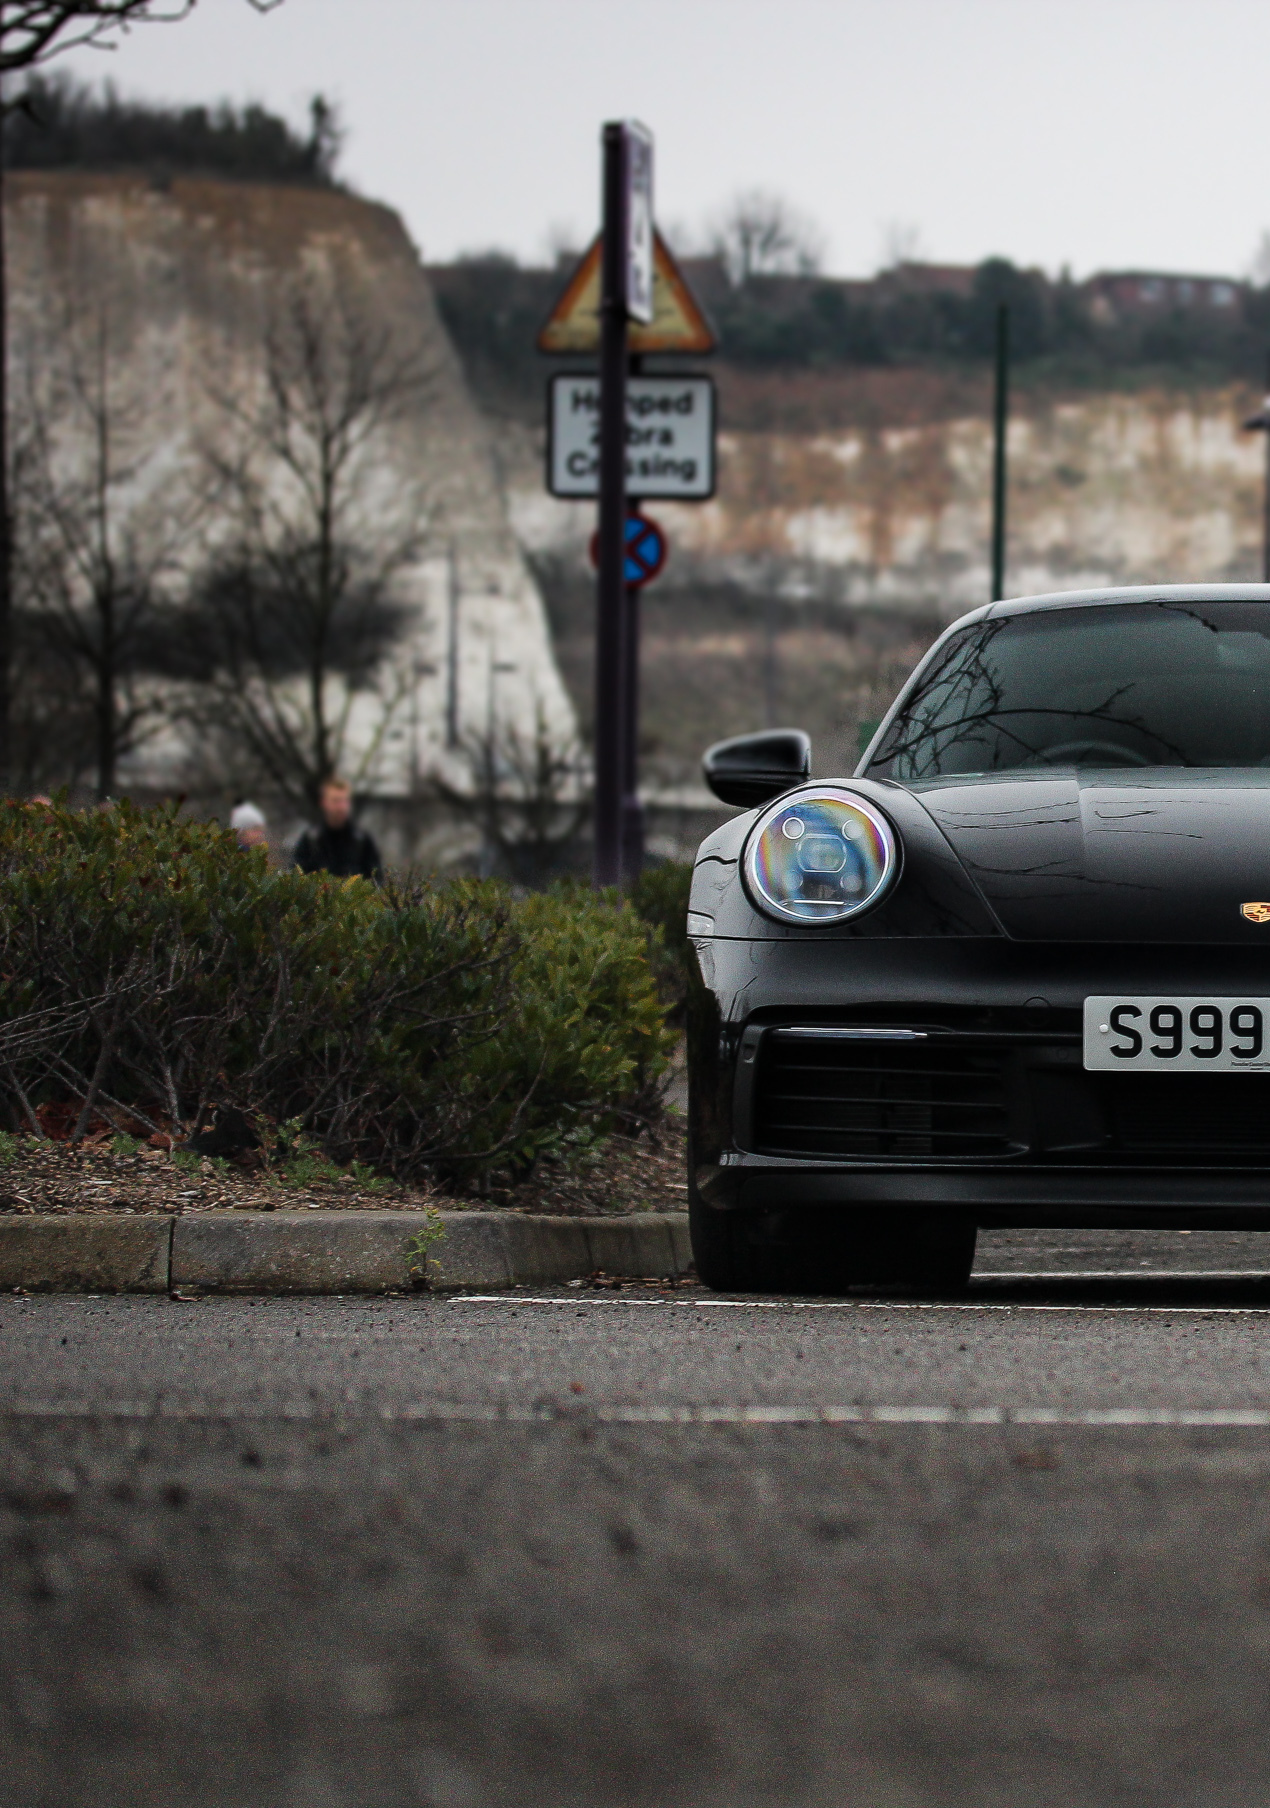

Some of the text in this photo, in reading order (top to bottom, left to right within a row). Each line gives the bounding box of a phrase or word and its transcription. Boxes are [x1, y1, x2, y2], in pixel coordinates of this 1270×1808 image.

[571, 388, 694, 417] Hped
[589, 420, 674, 447] Zbra
[566, 452, 697, 484] Crssing
[1109, 1004, 1264, 1059] S999
